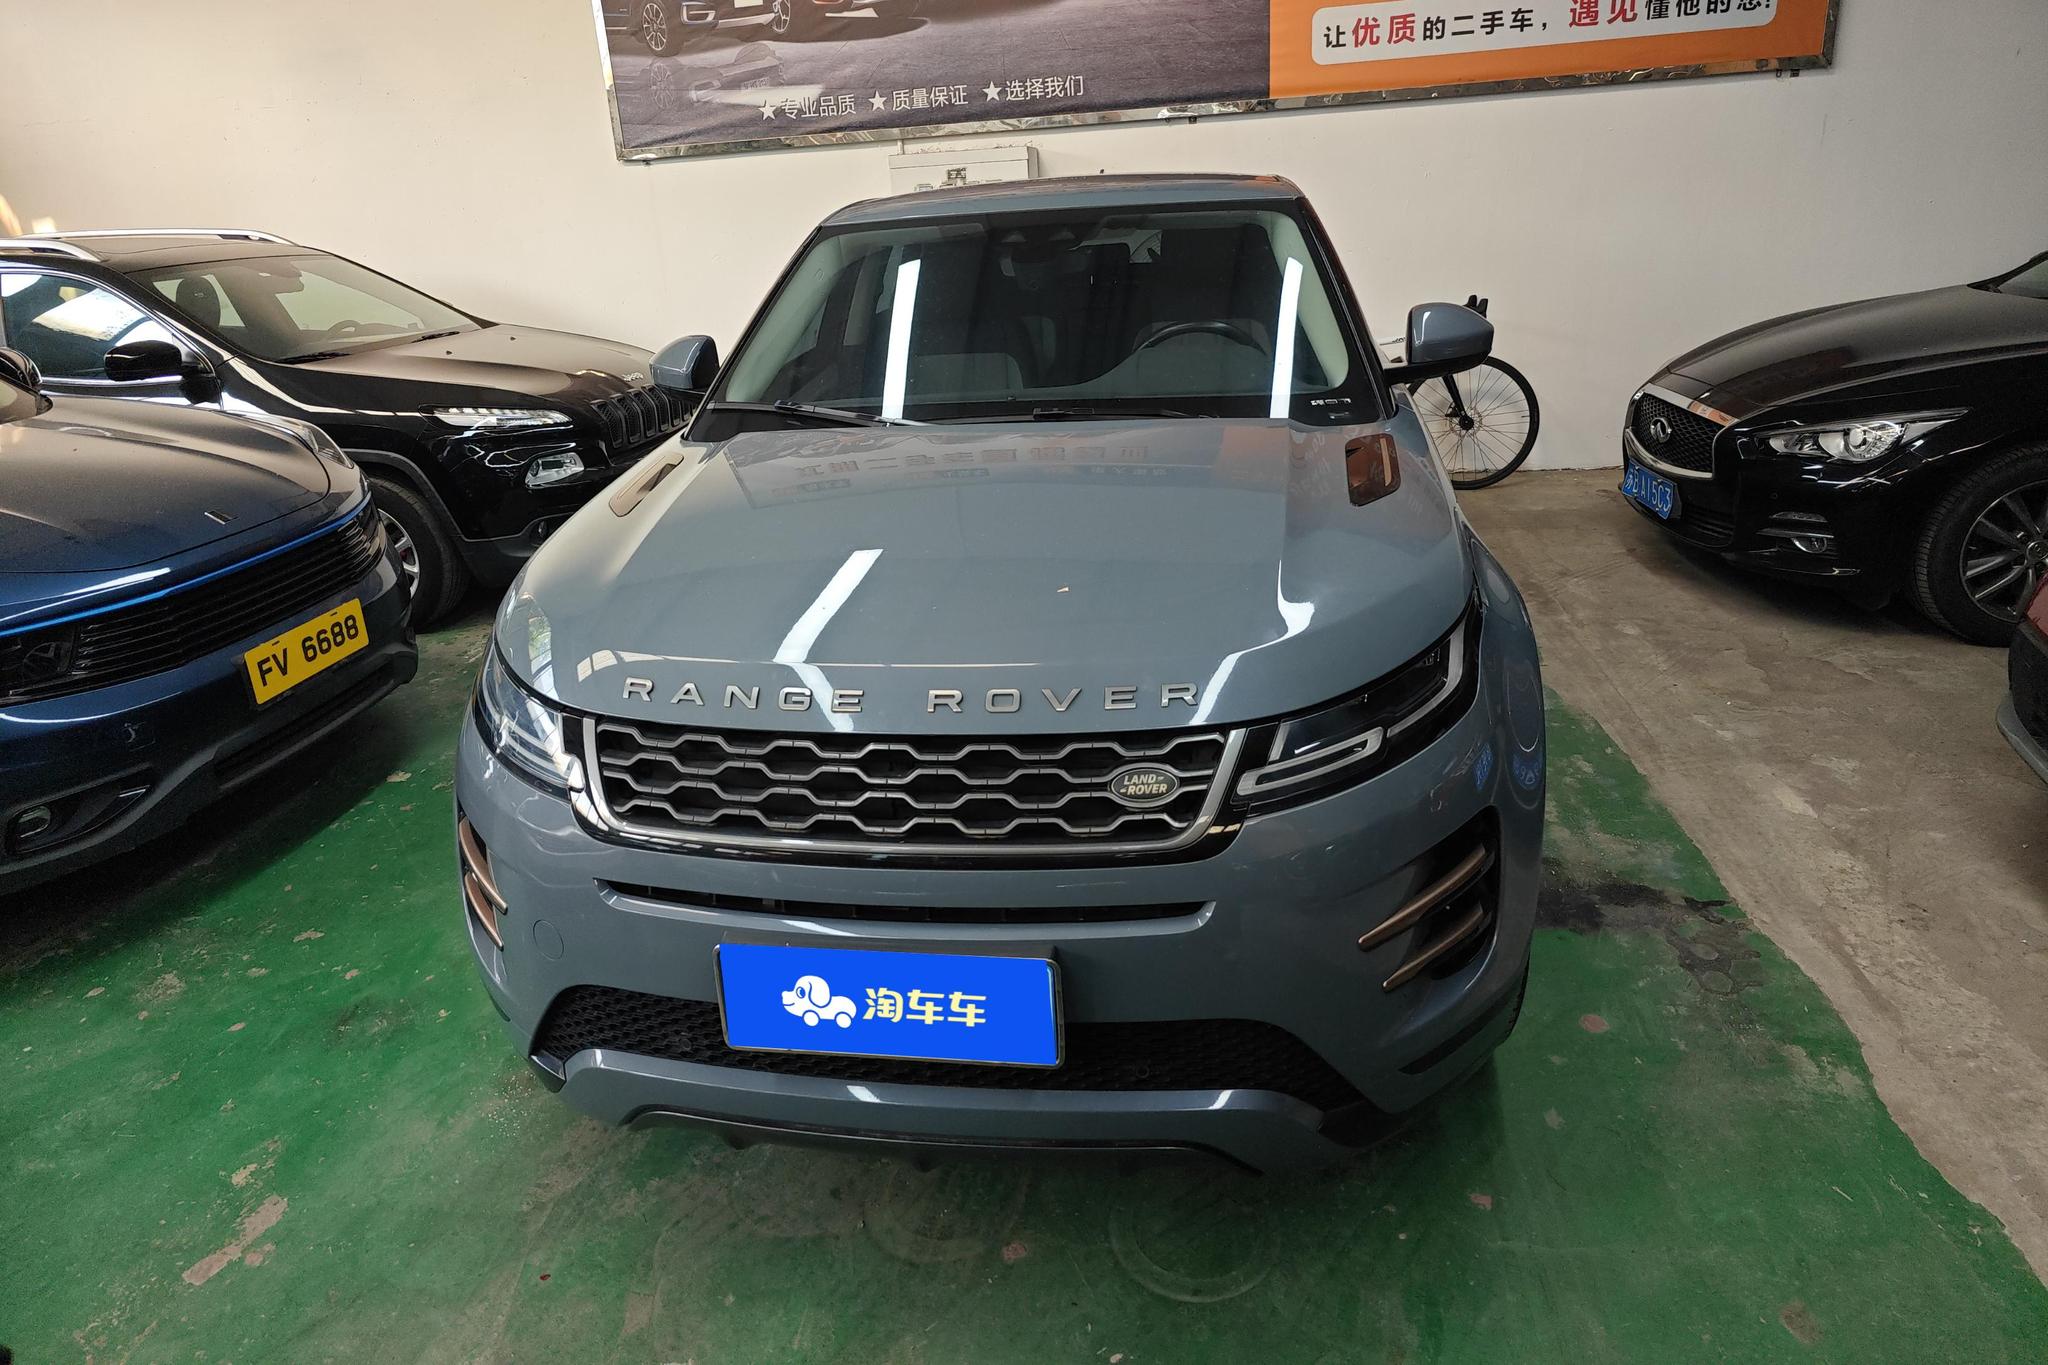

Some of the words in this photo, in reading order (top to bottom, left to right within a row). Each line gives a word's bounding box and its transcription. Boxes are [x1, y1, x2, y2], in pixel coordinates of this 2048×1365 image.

[781, 94, 856, 119] 专业品质
[892, 85, 968, 111] 质量保证
[1005, 75, 1084, 101] 选择我们
[256, 648, 288, 687] FV
[301, 614, 359, 663] 6688
[622, 676, 865, 713] RANGE
[926, 682, 1199, 714] ROVER
